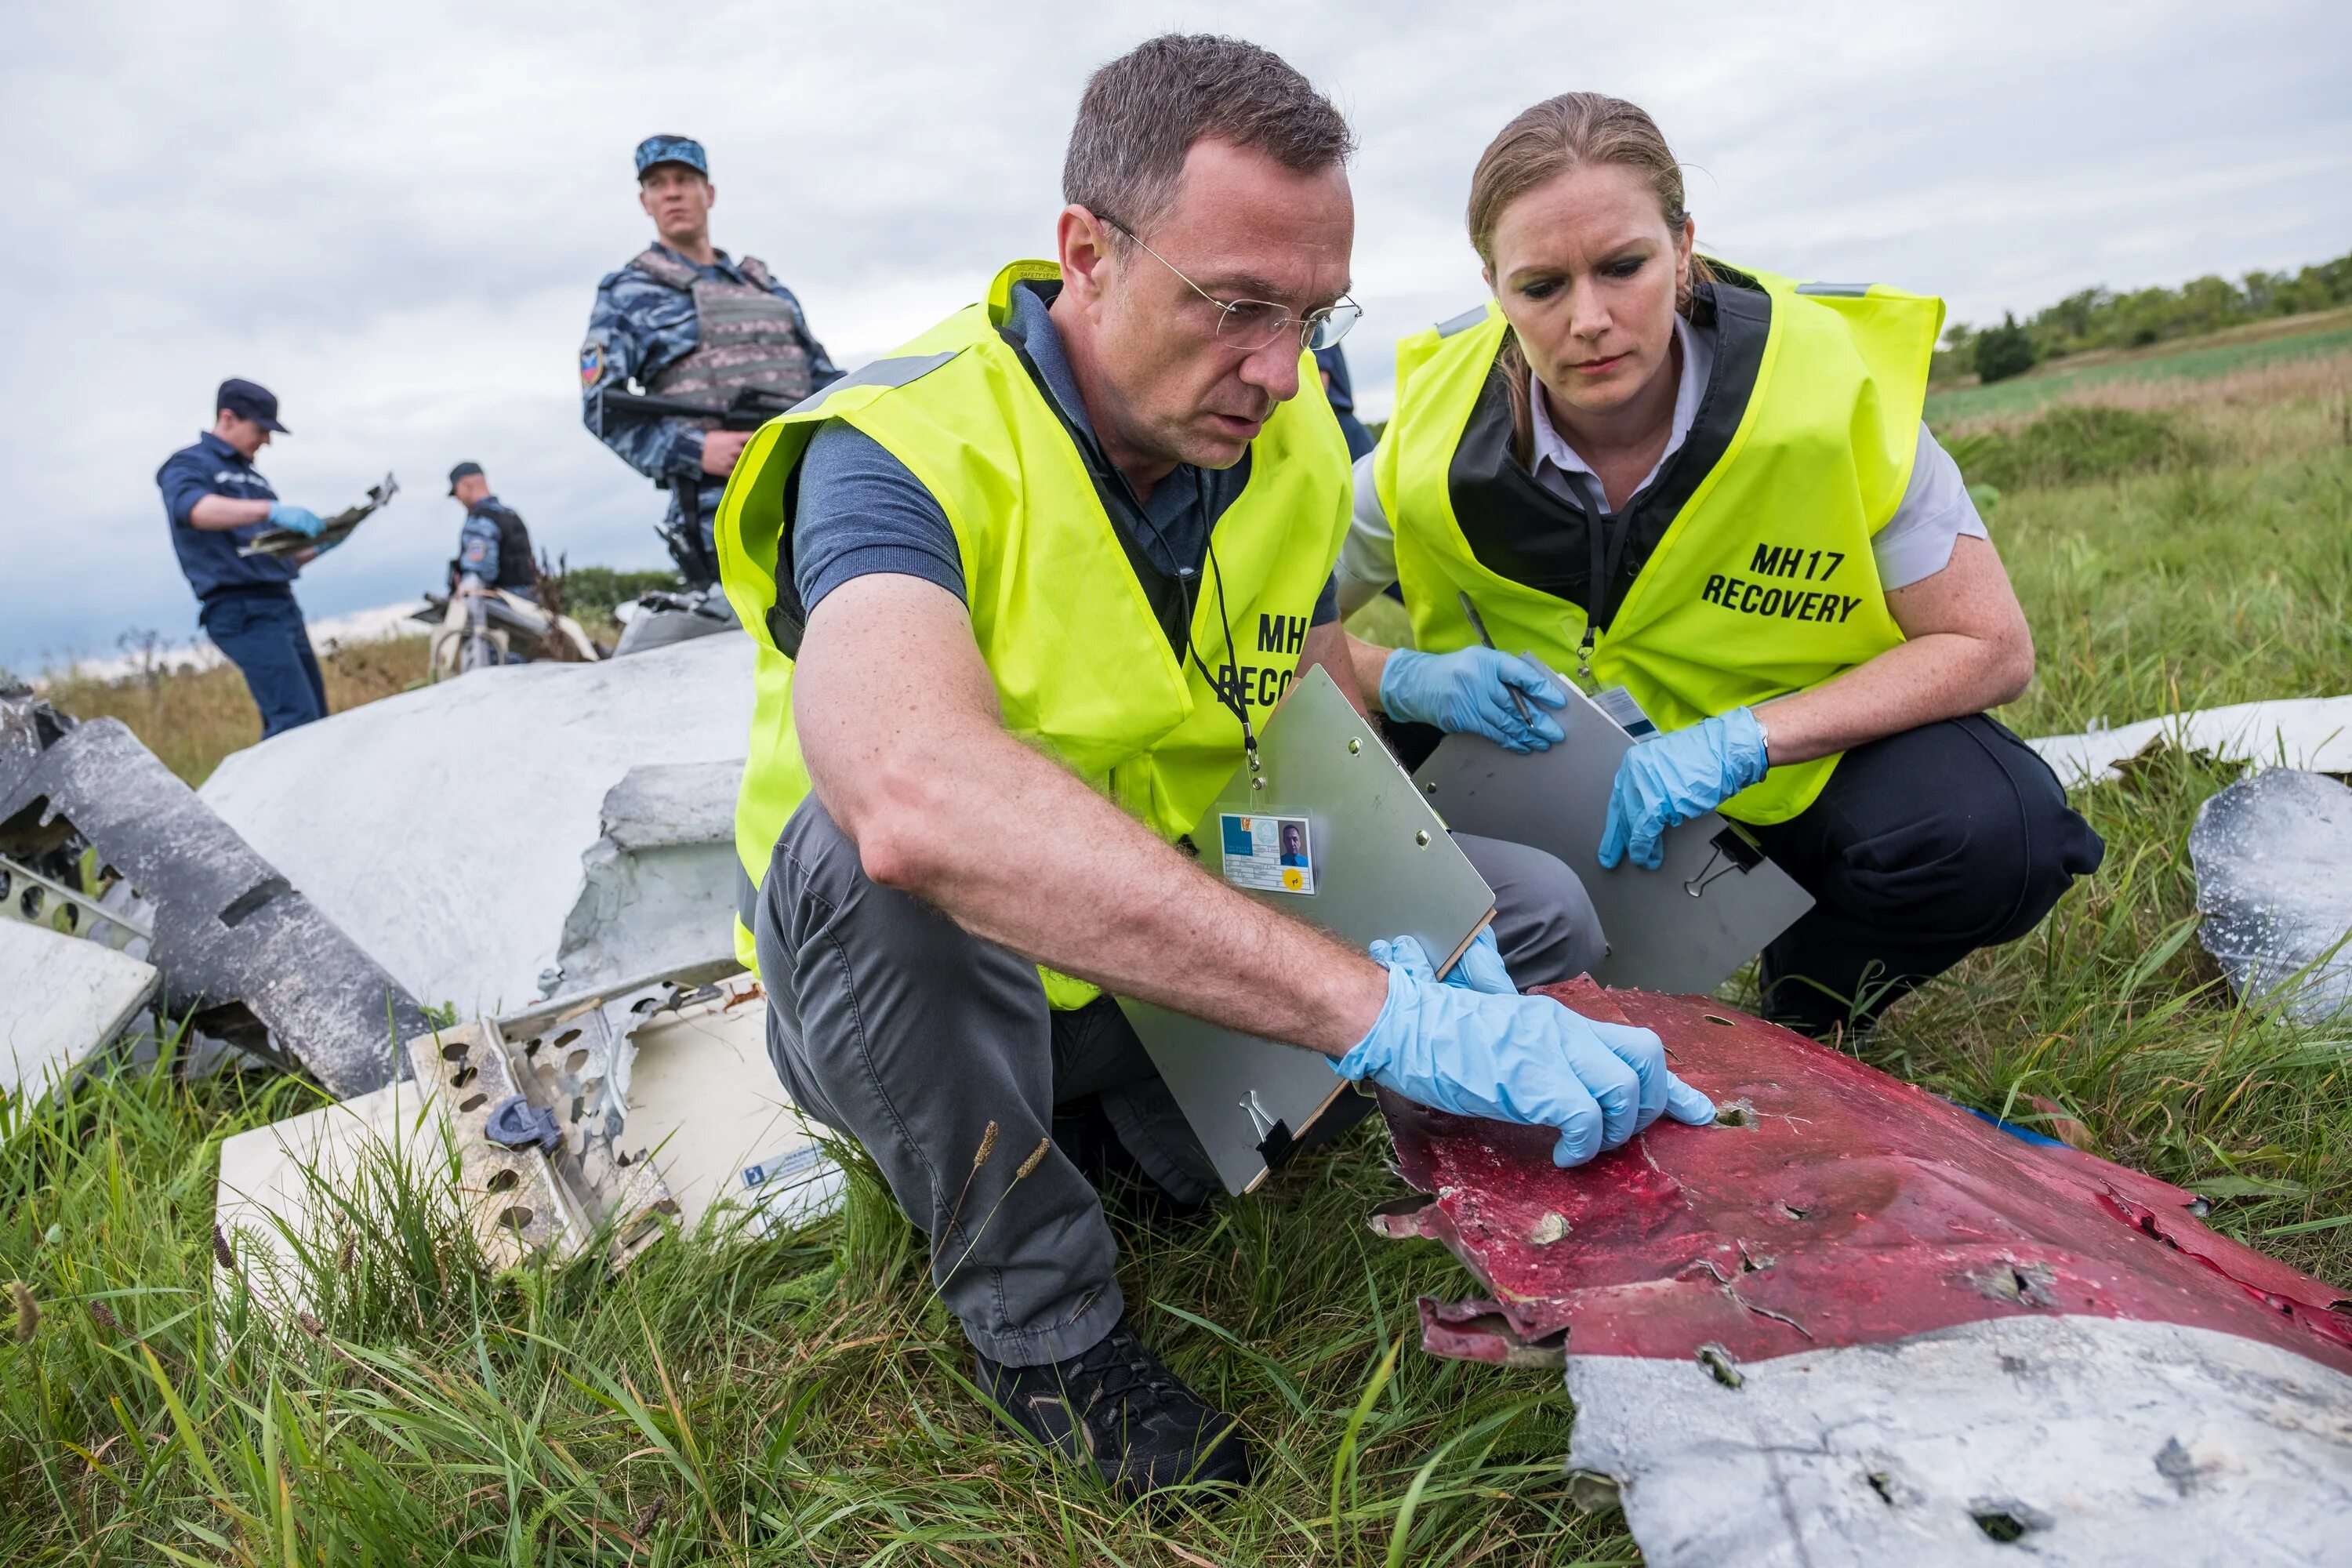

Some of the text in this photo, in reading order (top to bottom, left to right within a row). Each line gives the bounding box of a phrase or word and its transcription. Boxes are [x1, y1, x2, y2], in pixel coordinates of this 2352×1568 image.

[1749, 543, 1845, 582] MH17
[1701, 574, 1863, 623] RECOVERY
[1258, 613, 1307, 655] MH
